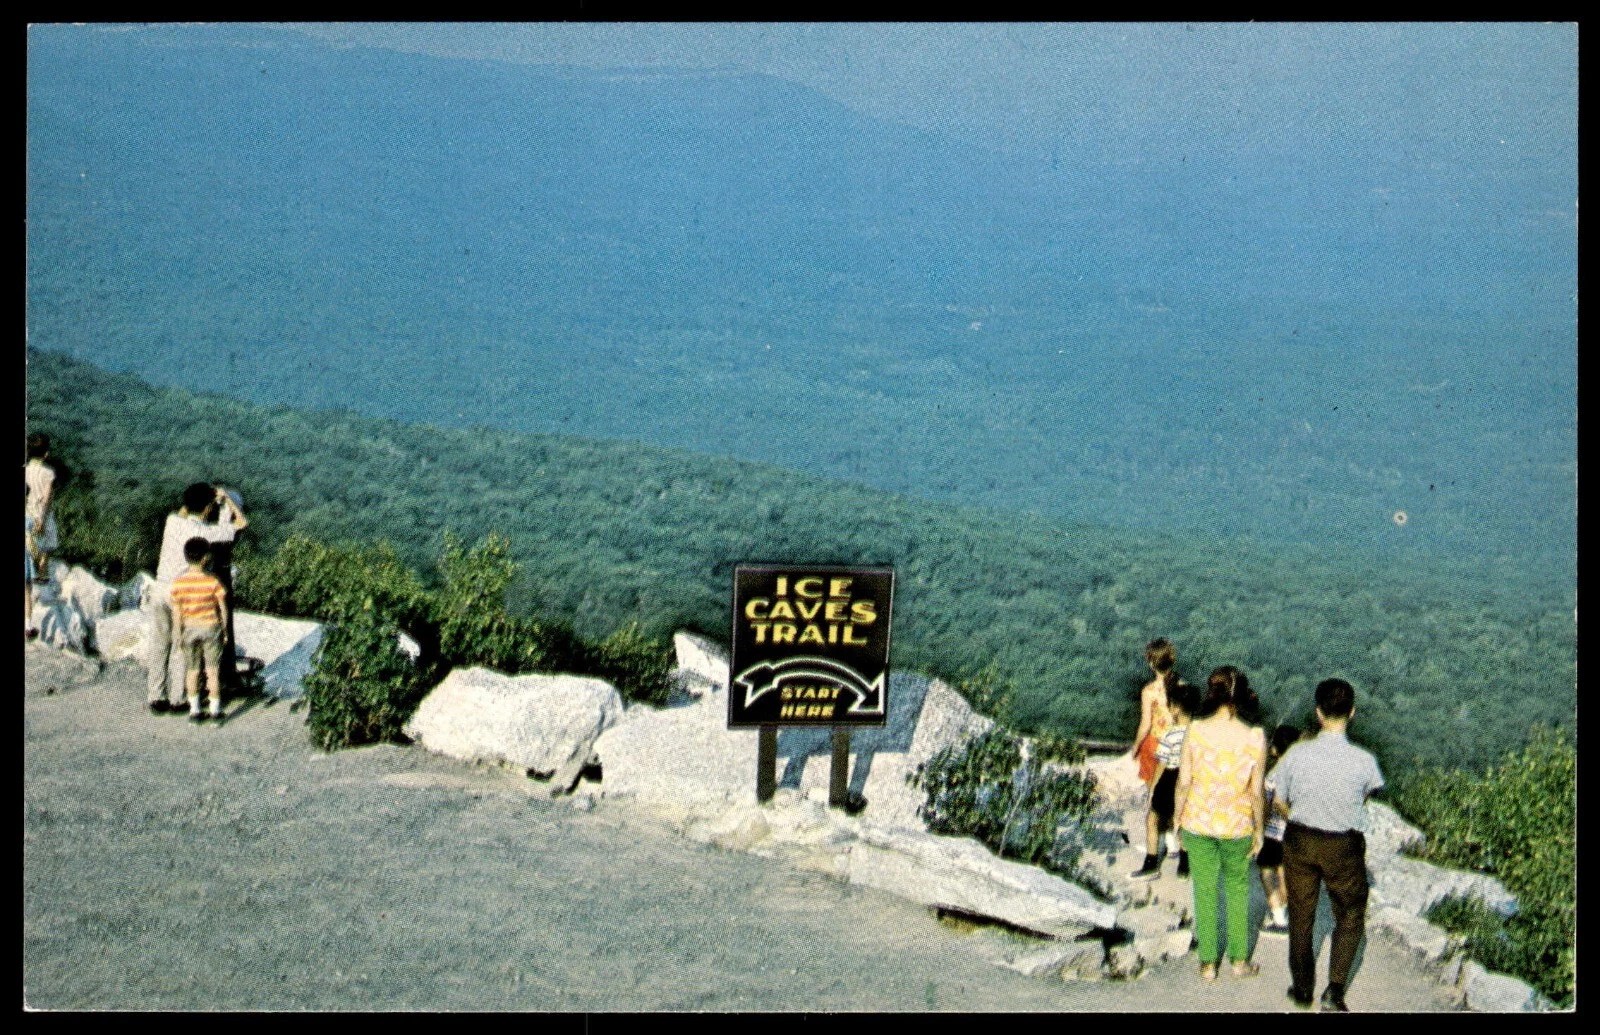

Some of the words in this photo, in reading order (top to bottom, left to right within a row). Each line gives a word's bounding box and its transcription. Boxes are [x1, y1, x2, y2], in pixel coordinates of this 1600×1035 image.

[776, 576, 852, 598] ICE
[745, 597, 877, 623] CAVES
[750, 623, 867, 645] TRAIL
[781, 686, 841, 699] START
[780, 704, 835, 718] HERE
